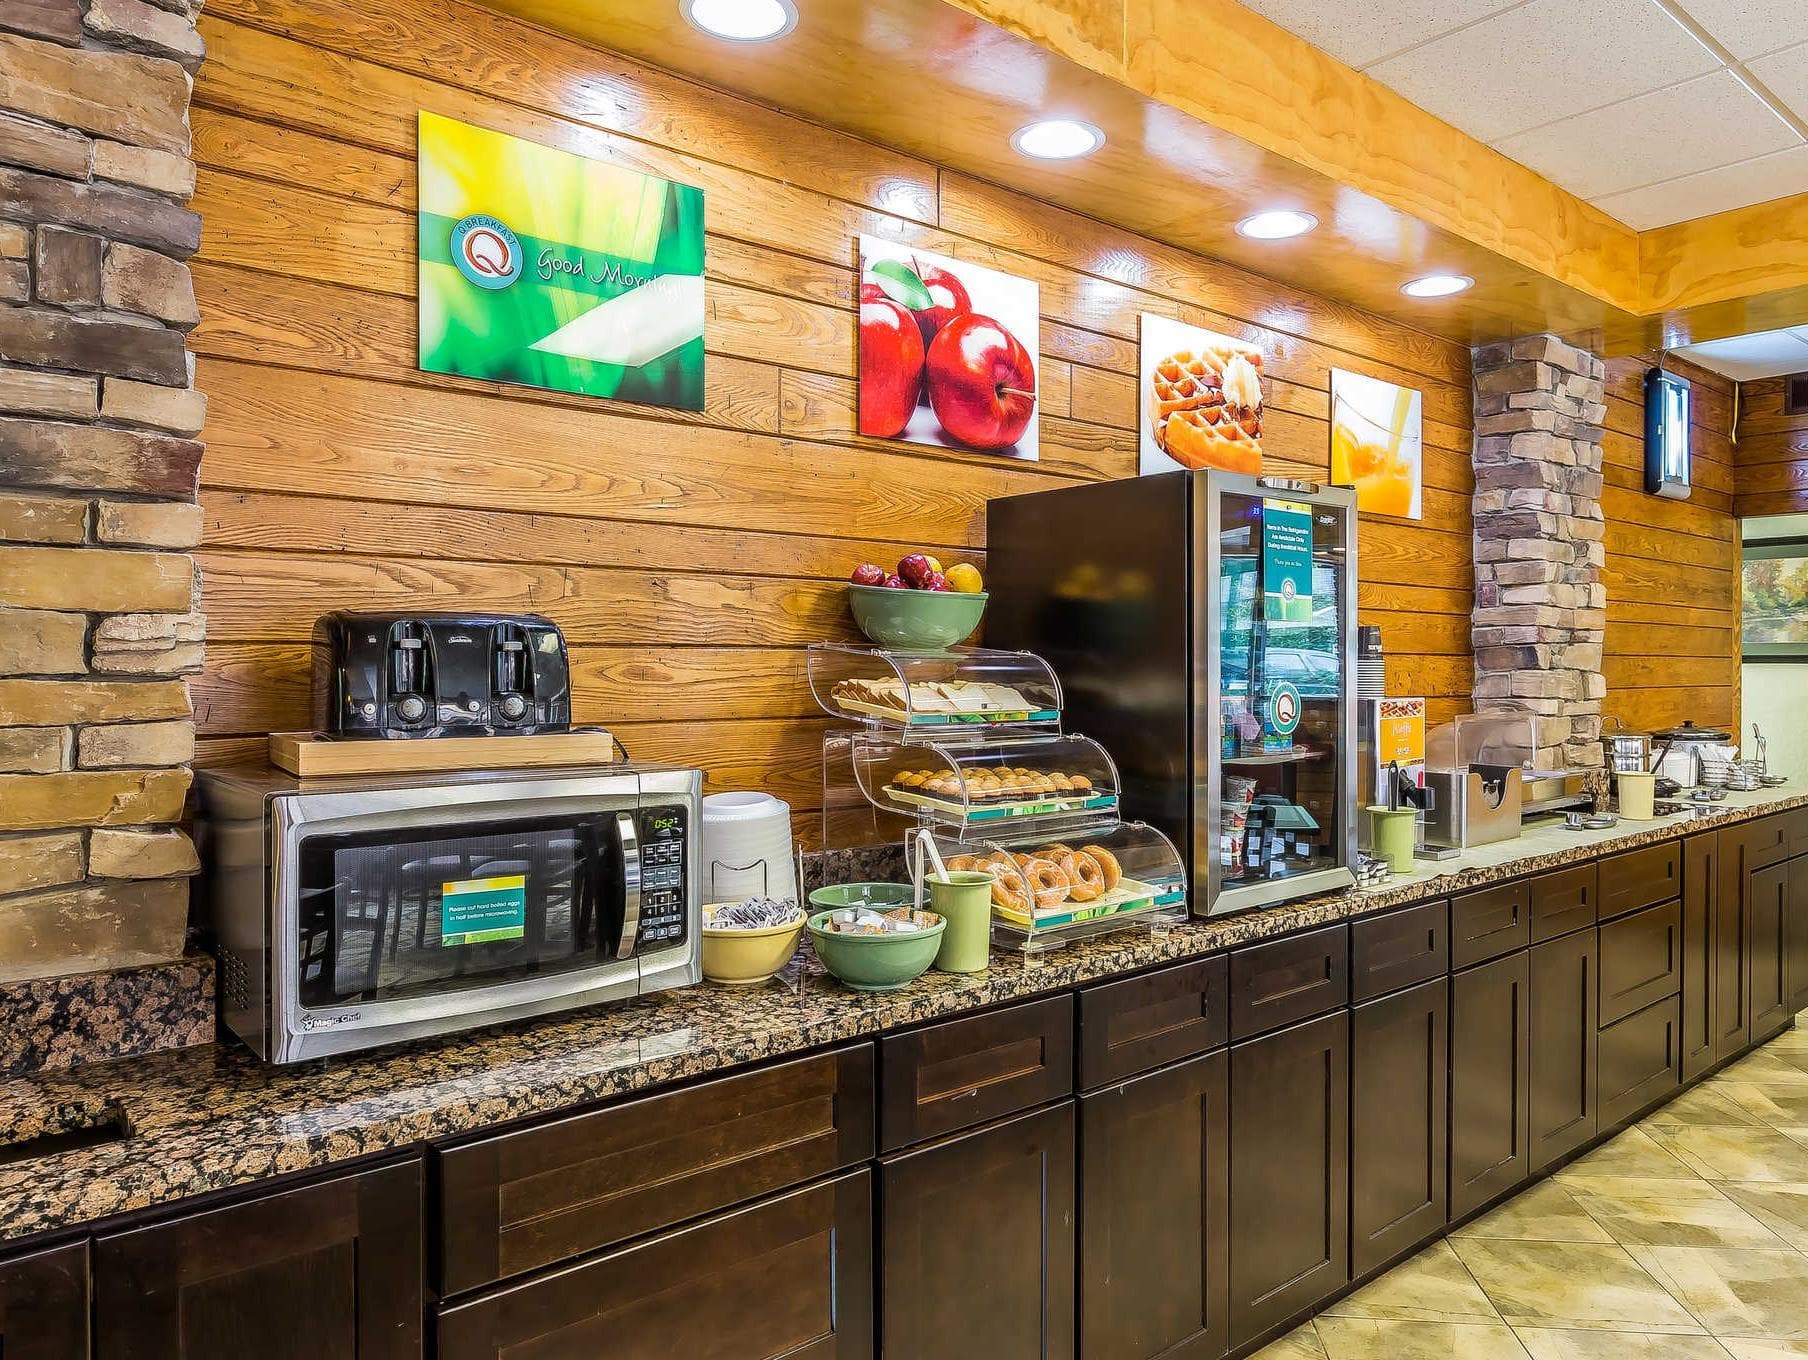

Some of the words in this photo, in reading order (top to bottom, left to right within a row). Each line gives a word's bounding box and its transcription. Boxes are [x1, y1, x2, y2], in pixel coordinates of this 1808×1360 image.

[465, 216, 517, 247] BREAKFAST
[464, 229, 514, 278] Q
[537, 248, 585, 281] Good
[1278, 694, 1296, 722] Q
[314, 1018, 340, 1027] Magic
[341, 1013, 361, 1023] Chef
